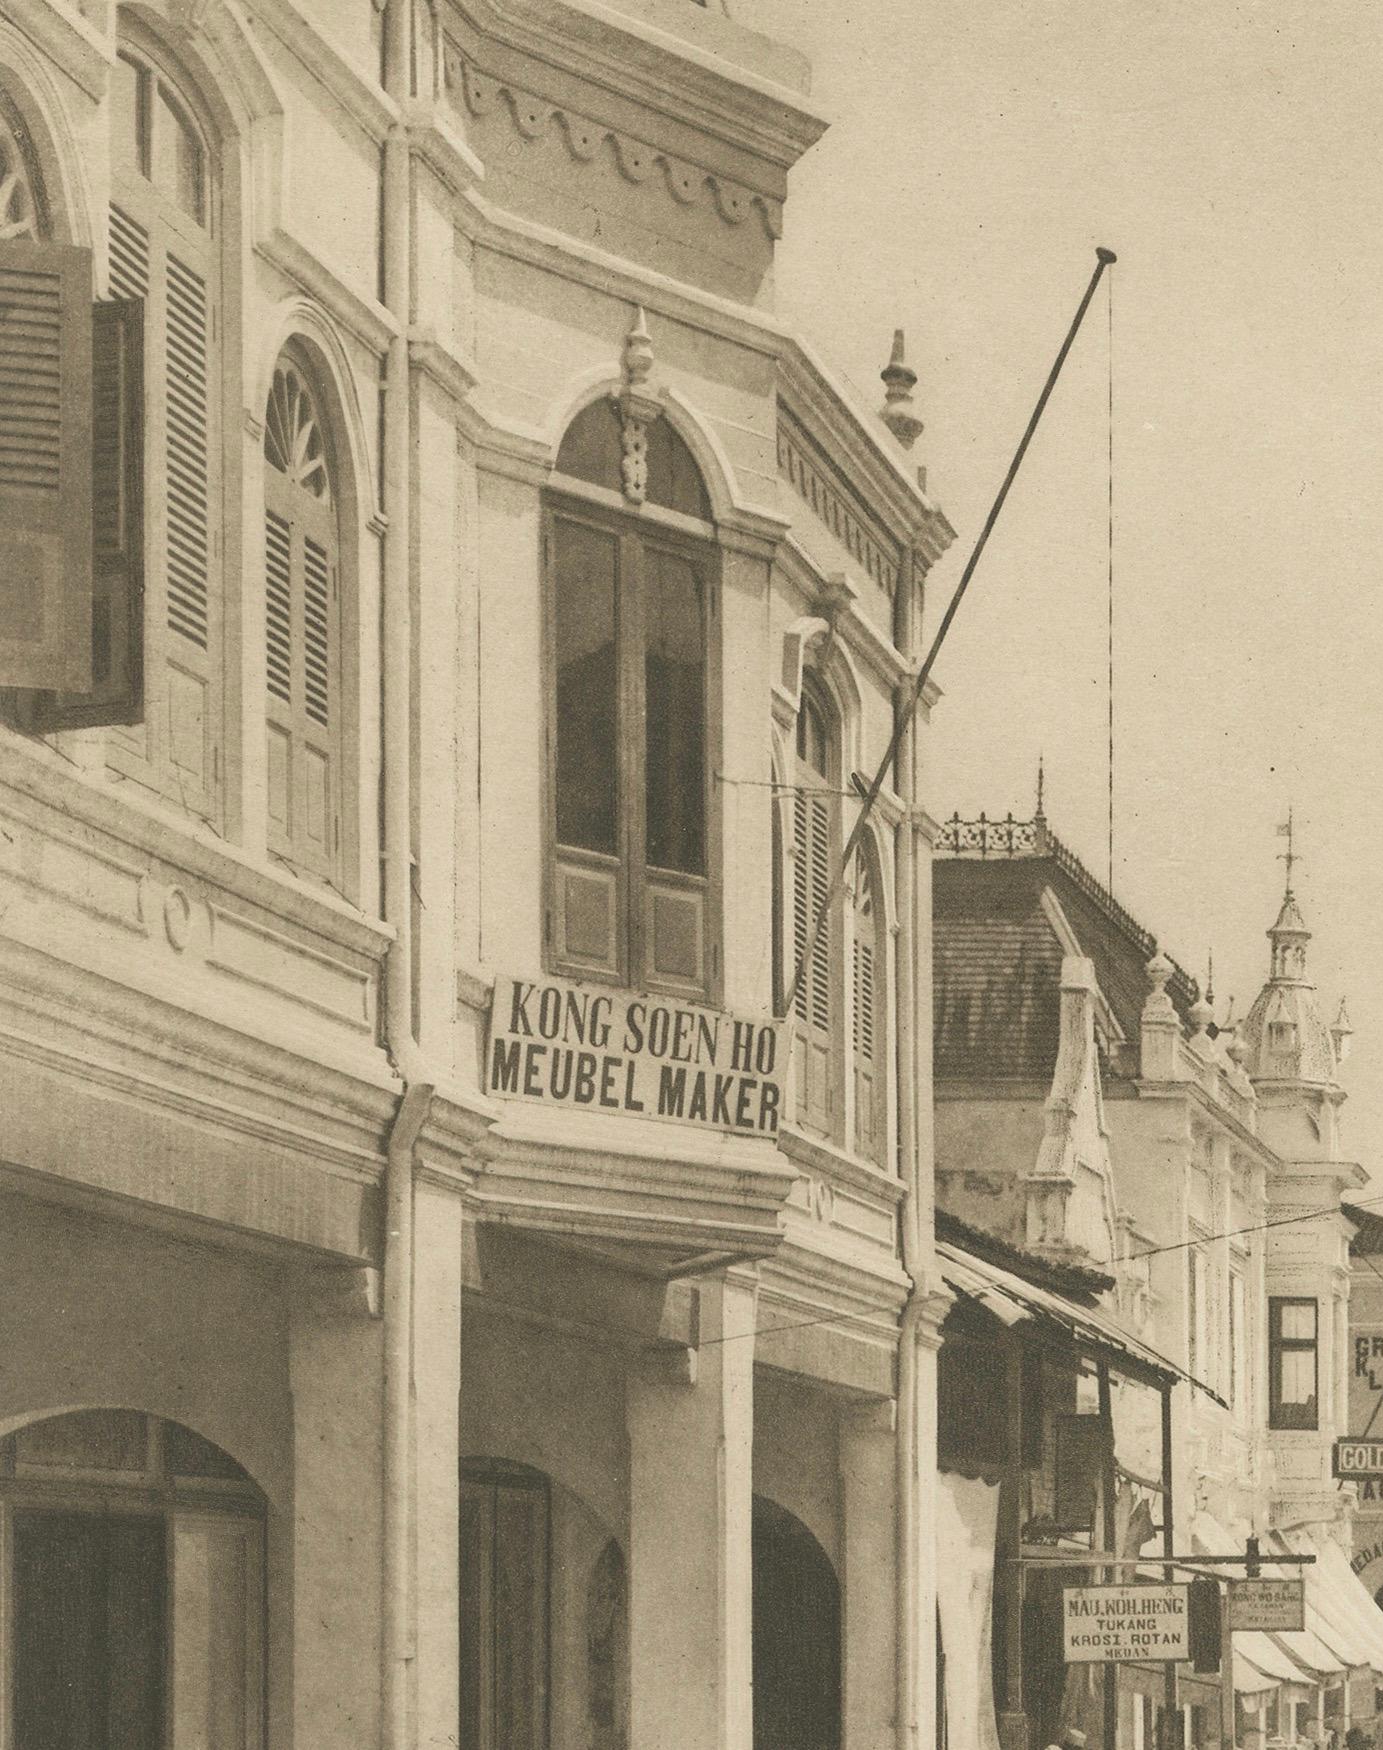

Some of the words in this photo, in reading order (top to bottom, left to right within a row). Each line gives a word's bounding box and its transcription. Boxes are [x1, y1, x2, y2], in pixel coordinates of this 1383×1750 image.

[508, 980, 613, 1047] KONG
[623, 1002, 721, 1066] SOEN
[730, 1020, 777, 1075] HO
[491, 1038, 644, 1112] MEUBEL
[658, 1064, 781, 1132] MAKER
[1096, 1619, 1156, 1631] TUKANG
[1131, 1633, 1181, 1645] ROTAN
[1105, 1648, 1150, 1658] MEDAN
